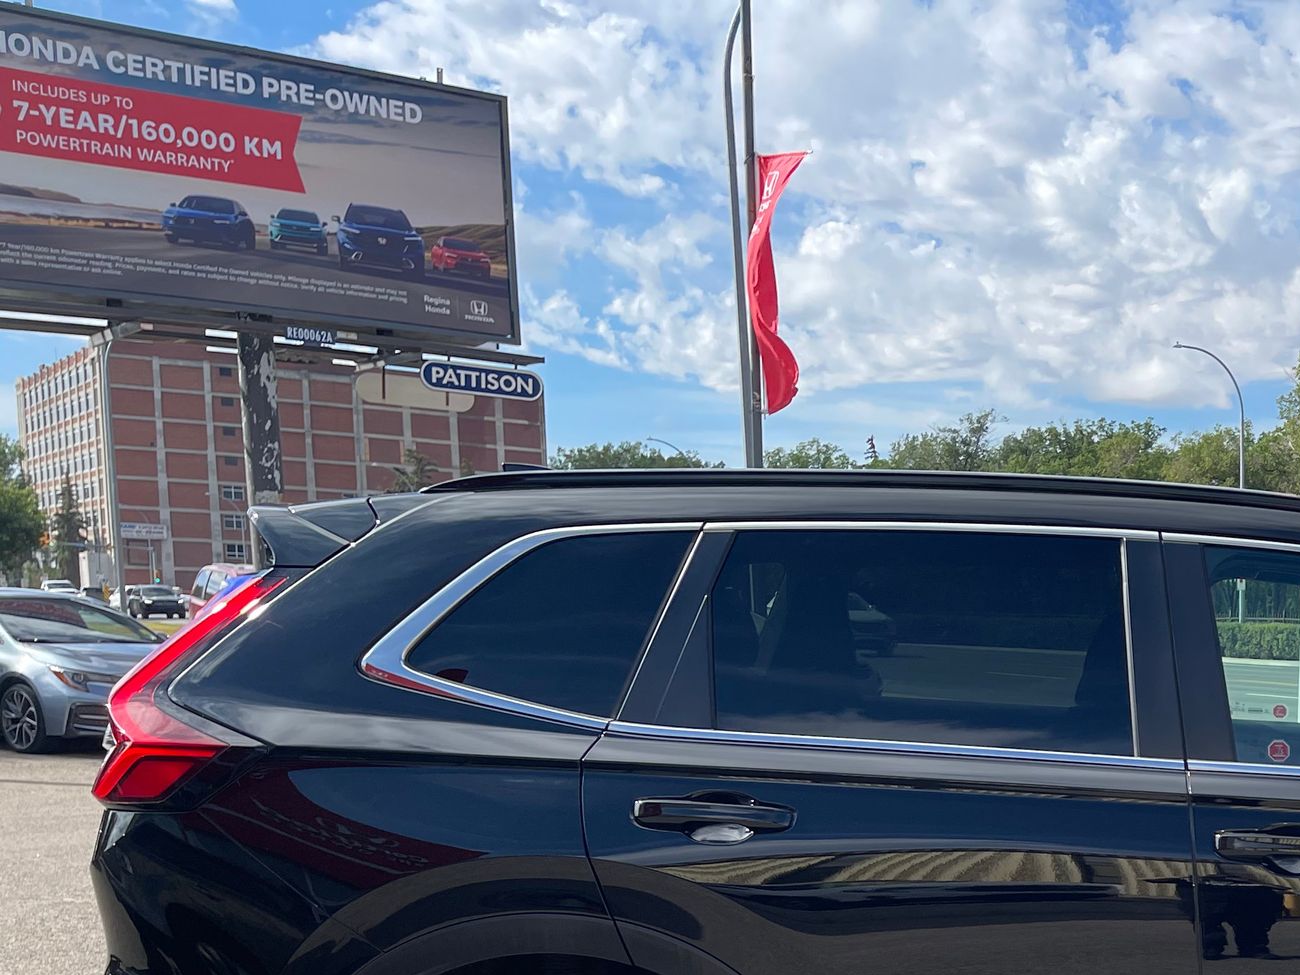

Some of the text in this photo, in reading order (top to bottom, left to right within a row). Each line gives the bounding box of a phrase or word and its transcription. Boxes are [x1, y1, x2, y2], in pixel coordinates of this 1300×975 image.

[12, 79, 133, 110] INCLUDES UP TO
[106, 50, 256, 95] CERTIFIED
[262, 76, 423, 124] PRE-OWNED
[13, 99, 282, 160] 7-YEAR/160,000 KM
[16, 129, 132, 160] POWERTRAIN
[423, 294, 451, 306] Regina
[425, 304, 451, 315] Honda
[286, 326, 333, 343] RE00062A
[431, 366, 534, 394] PATTISON
